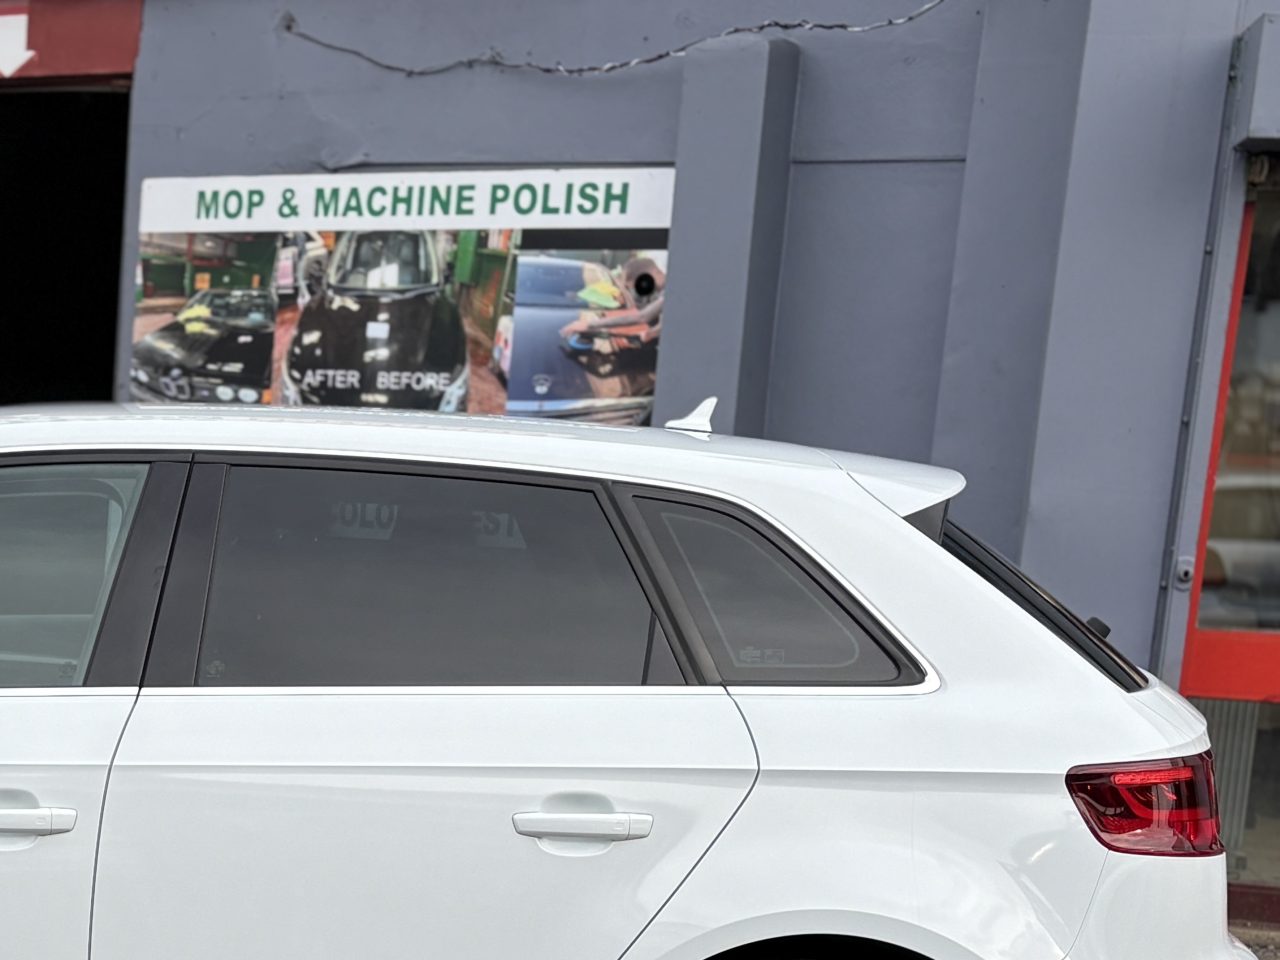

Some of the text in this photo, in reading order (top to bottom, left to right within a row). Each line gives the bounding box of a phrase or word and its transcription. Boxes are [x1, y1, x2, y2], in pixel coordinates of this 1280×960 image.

[196, 181, 630, 221] MOP & MACHINE POLISH
[301, 369, 451, 391] AFTER BEFORE
